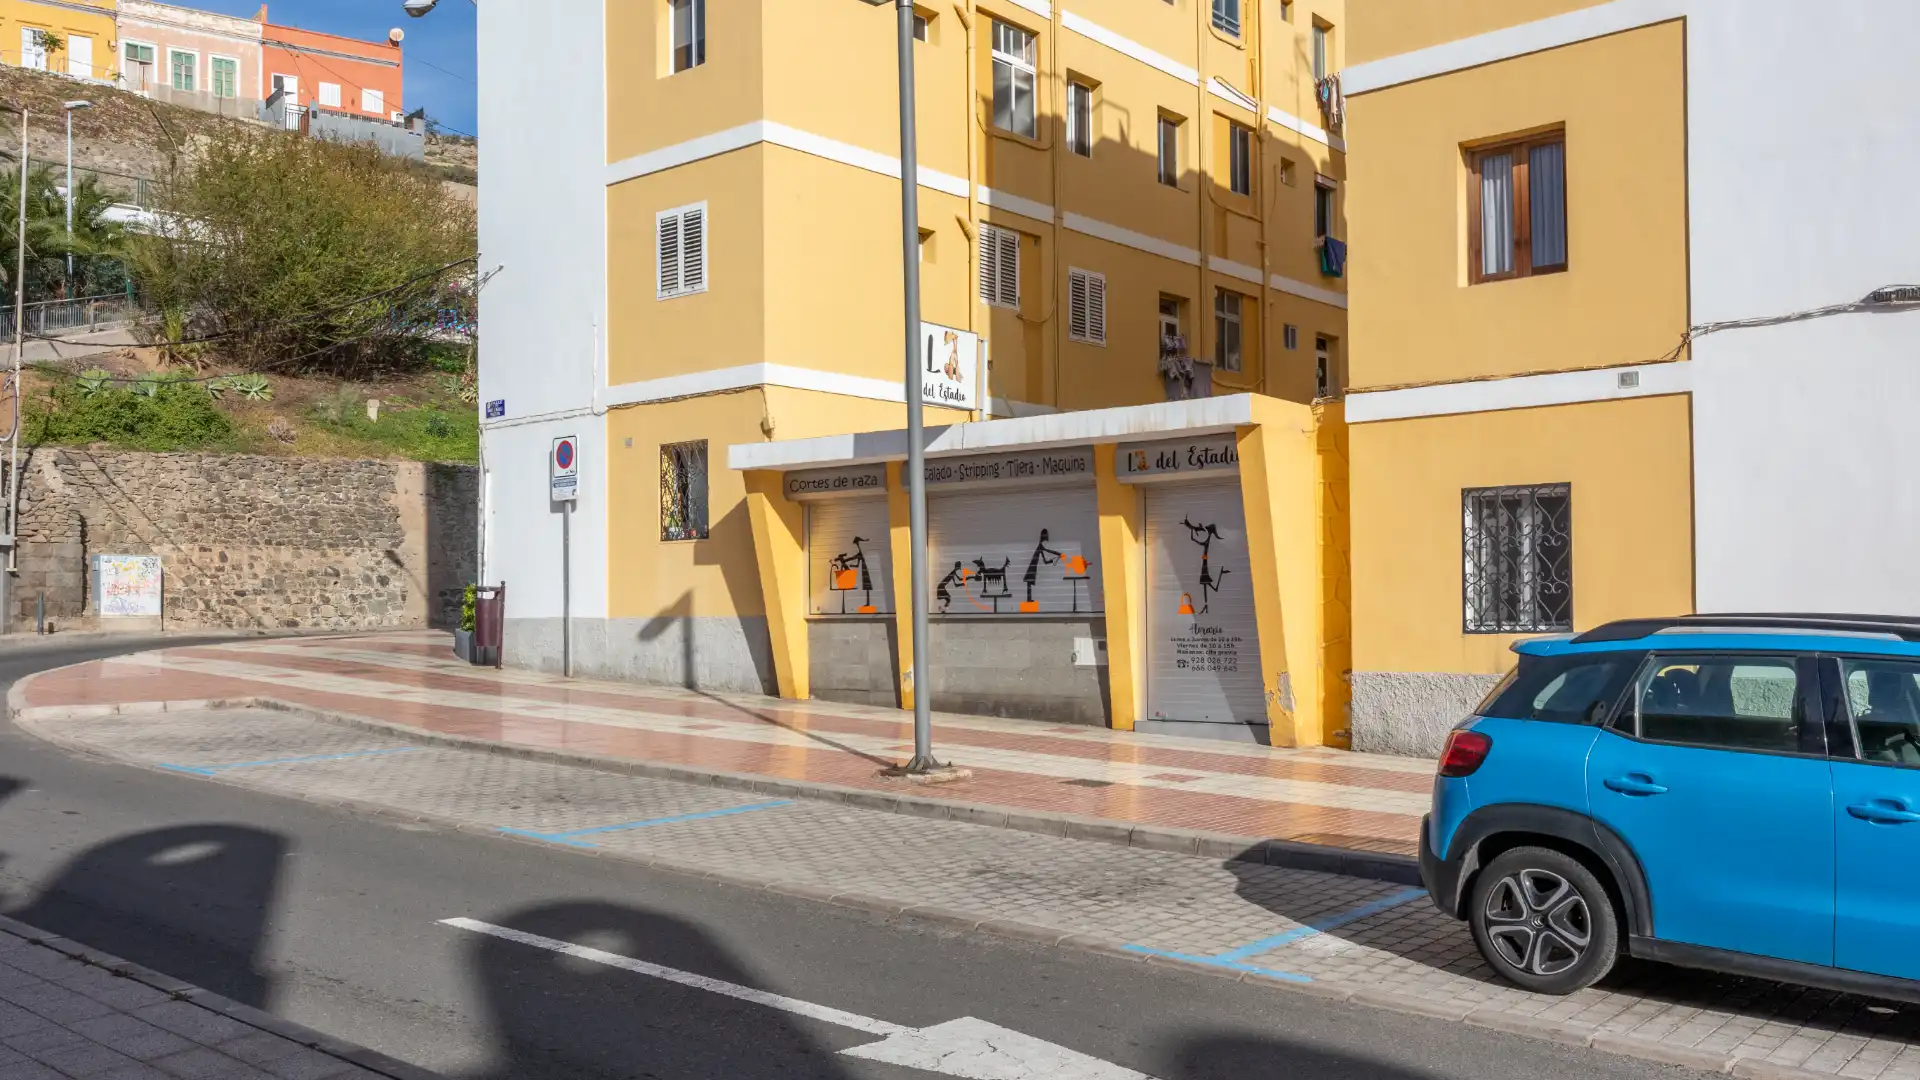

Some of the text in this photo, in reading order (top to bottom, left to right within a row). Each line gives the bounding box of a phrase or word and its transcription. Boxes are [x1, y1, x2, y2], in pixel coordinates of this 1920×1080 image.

[923, 383, 966, 402] del Estadio
[1156, 449, 1180, 470] del
[959, 462, 1000, 482] Stripping
[1007, 458, 1034, 477] Tijera
[789, 474, 878, 493] Cortes de raza
[1191, 664, 1205, 672] 666
